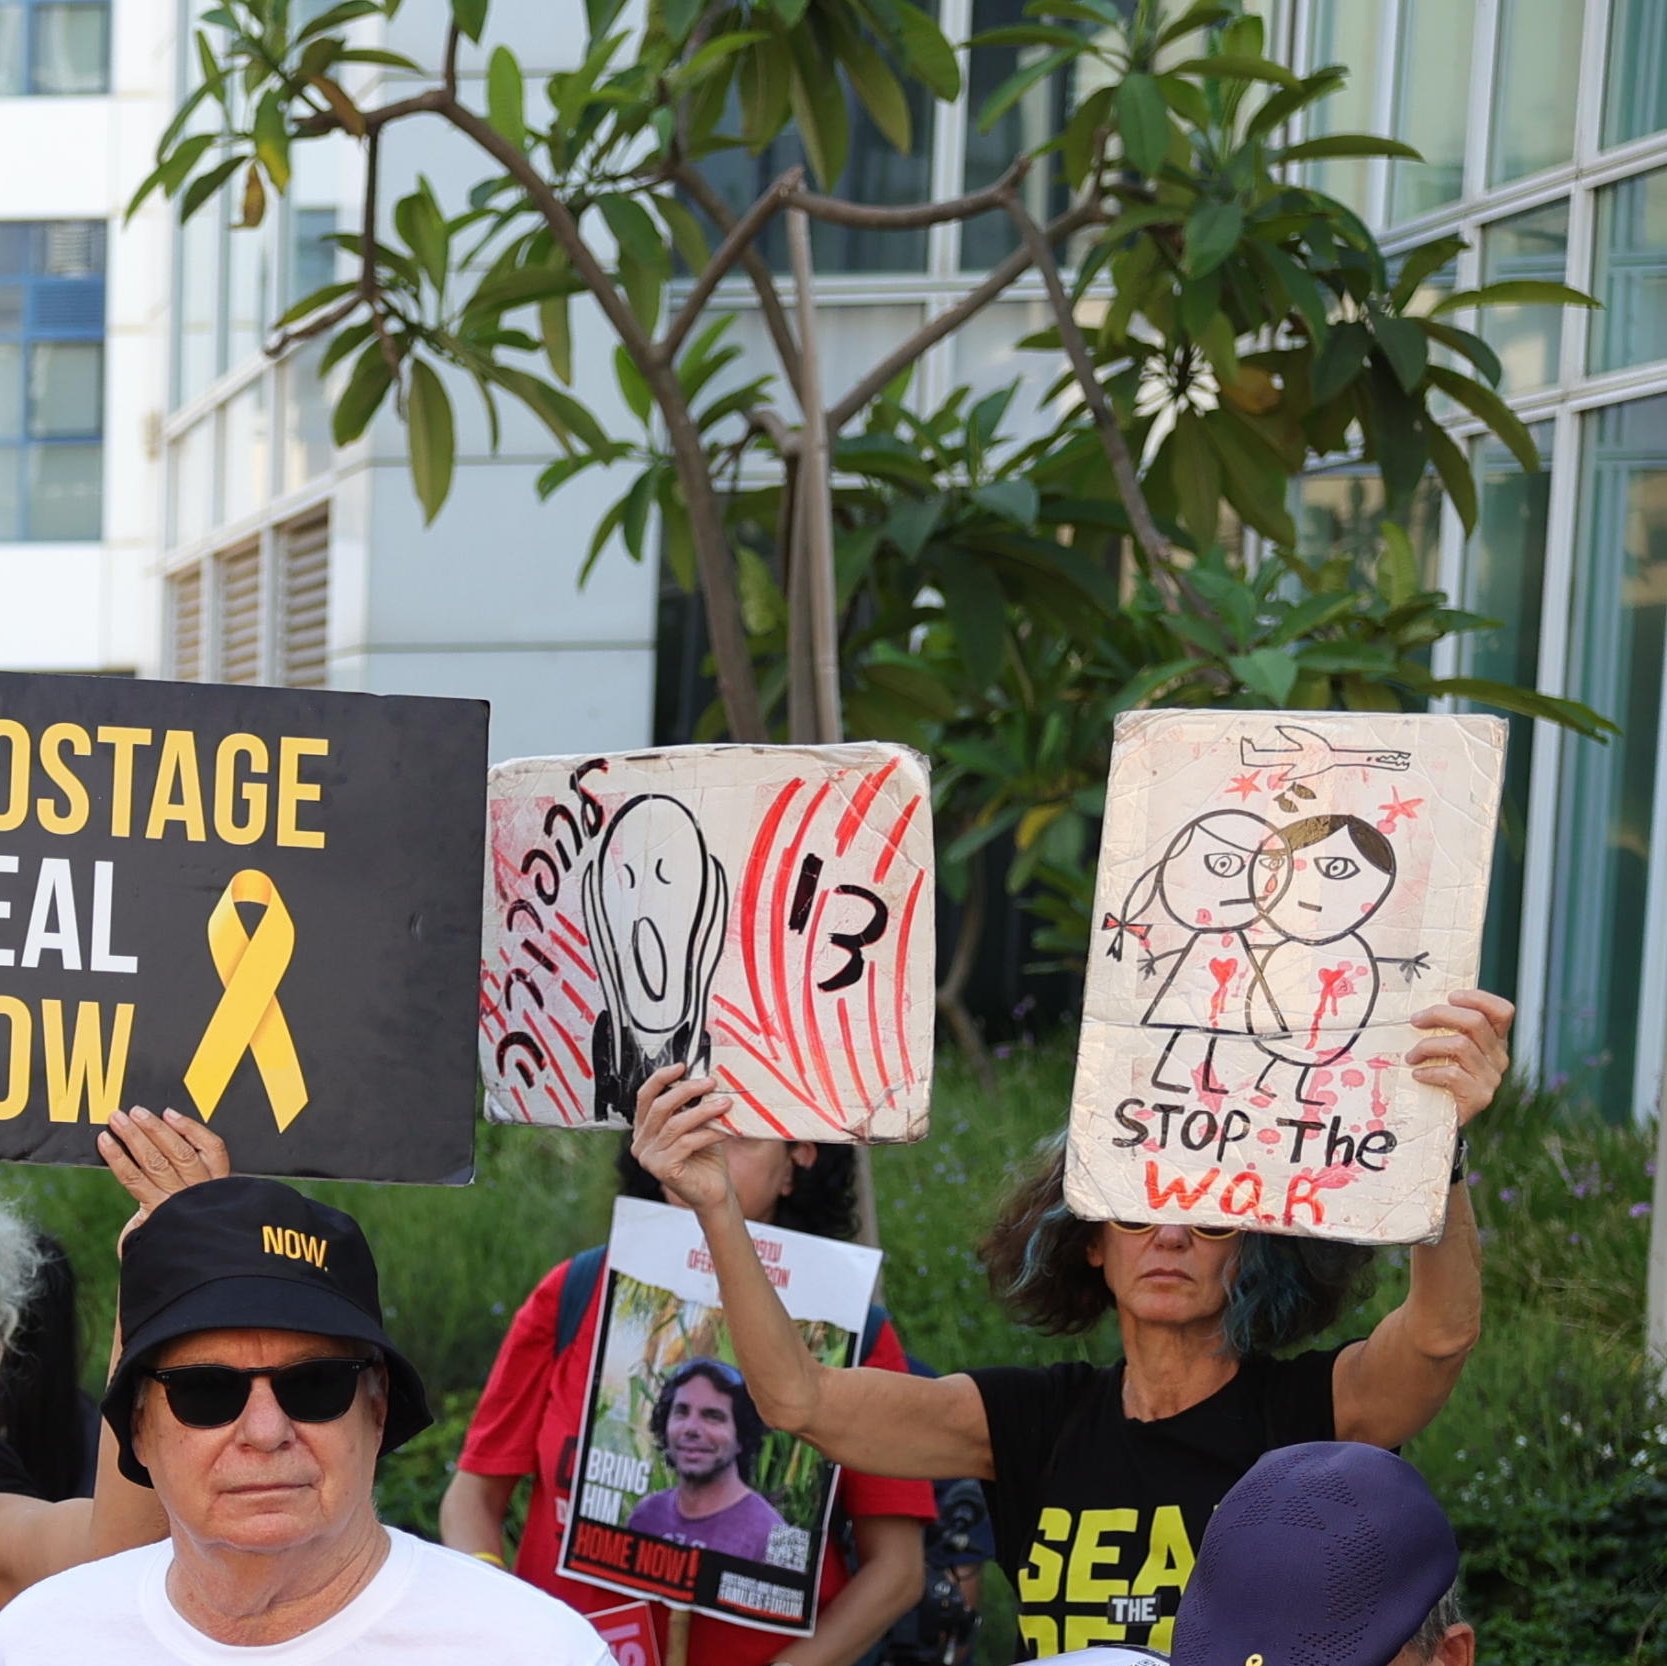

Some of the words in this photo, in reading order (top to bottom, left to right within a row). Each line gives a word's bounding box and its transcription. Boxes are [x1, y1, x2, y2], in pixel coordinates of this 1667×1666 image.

[1111, 1097, 1251, 1163] STOP
[1276, 1115, 1398, 1171] The
[585, 1447, 651, 1495] BRING
[579, 1483, 622, 1525] HIM
[574, 1523, 634, 1568] HOME
[637, 1539, 701, 1588] NOW!
[1018, 1504, 1196, 1603] SEA
[1111, 1597, 1157, 1622] THE
